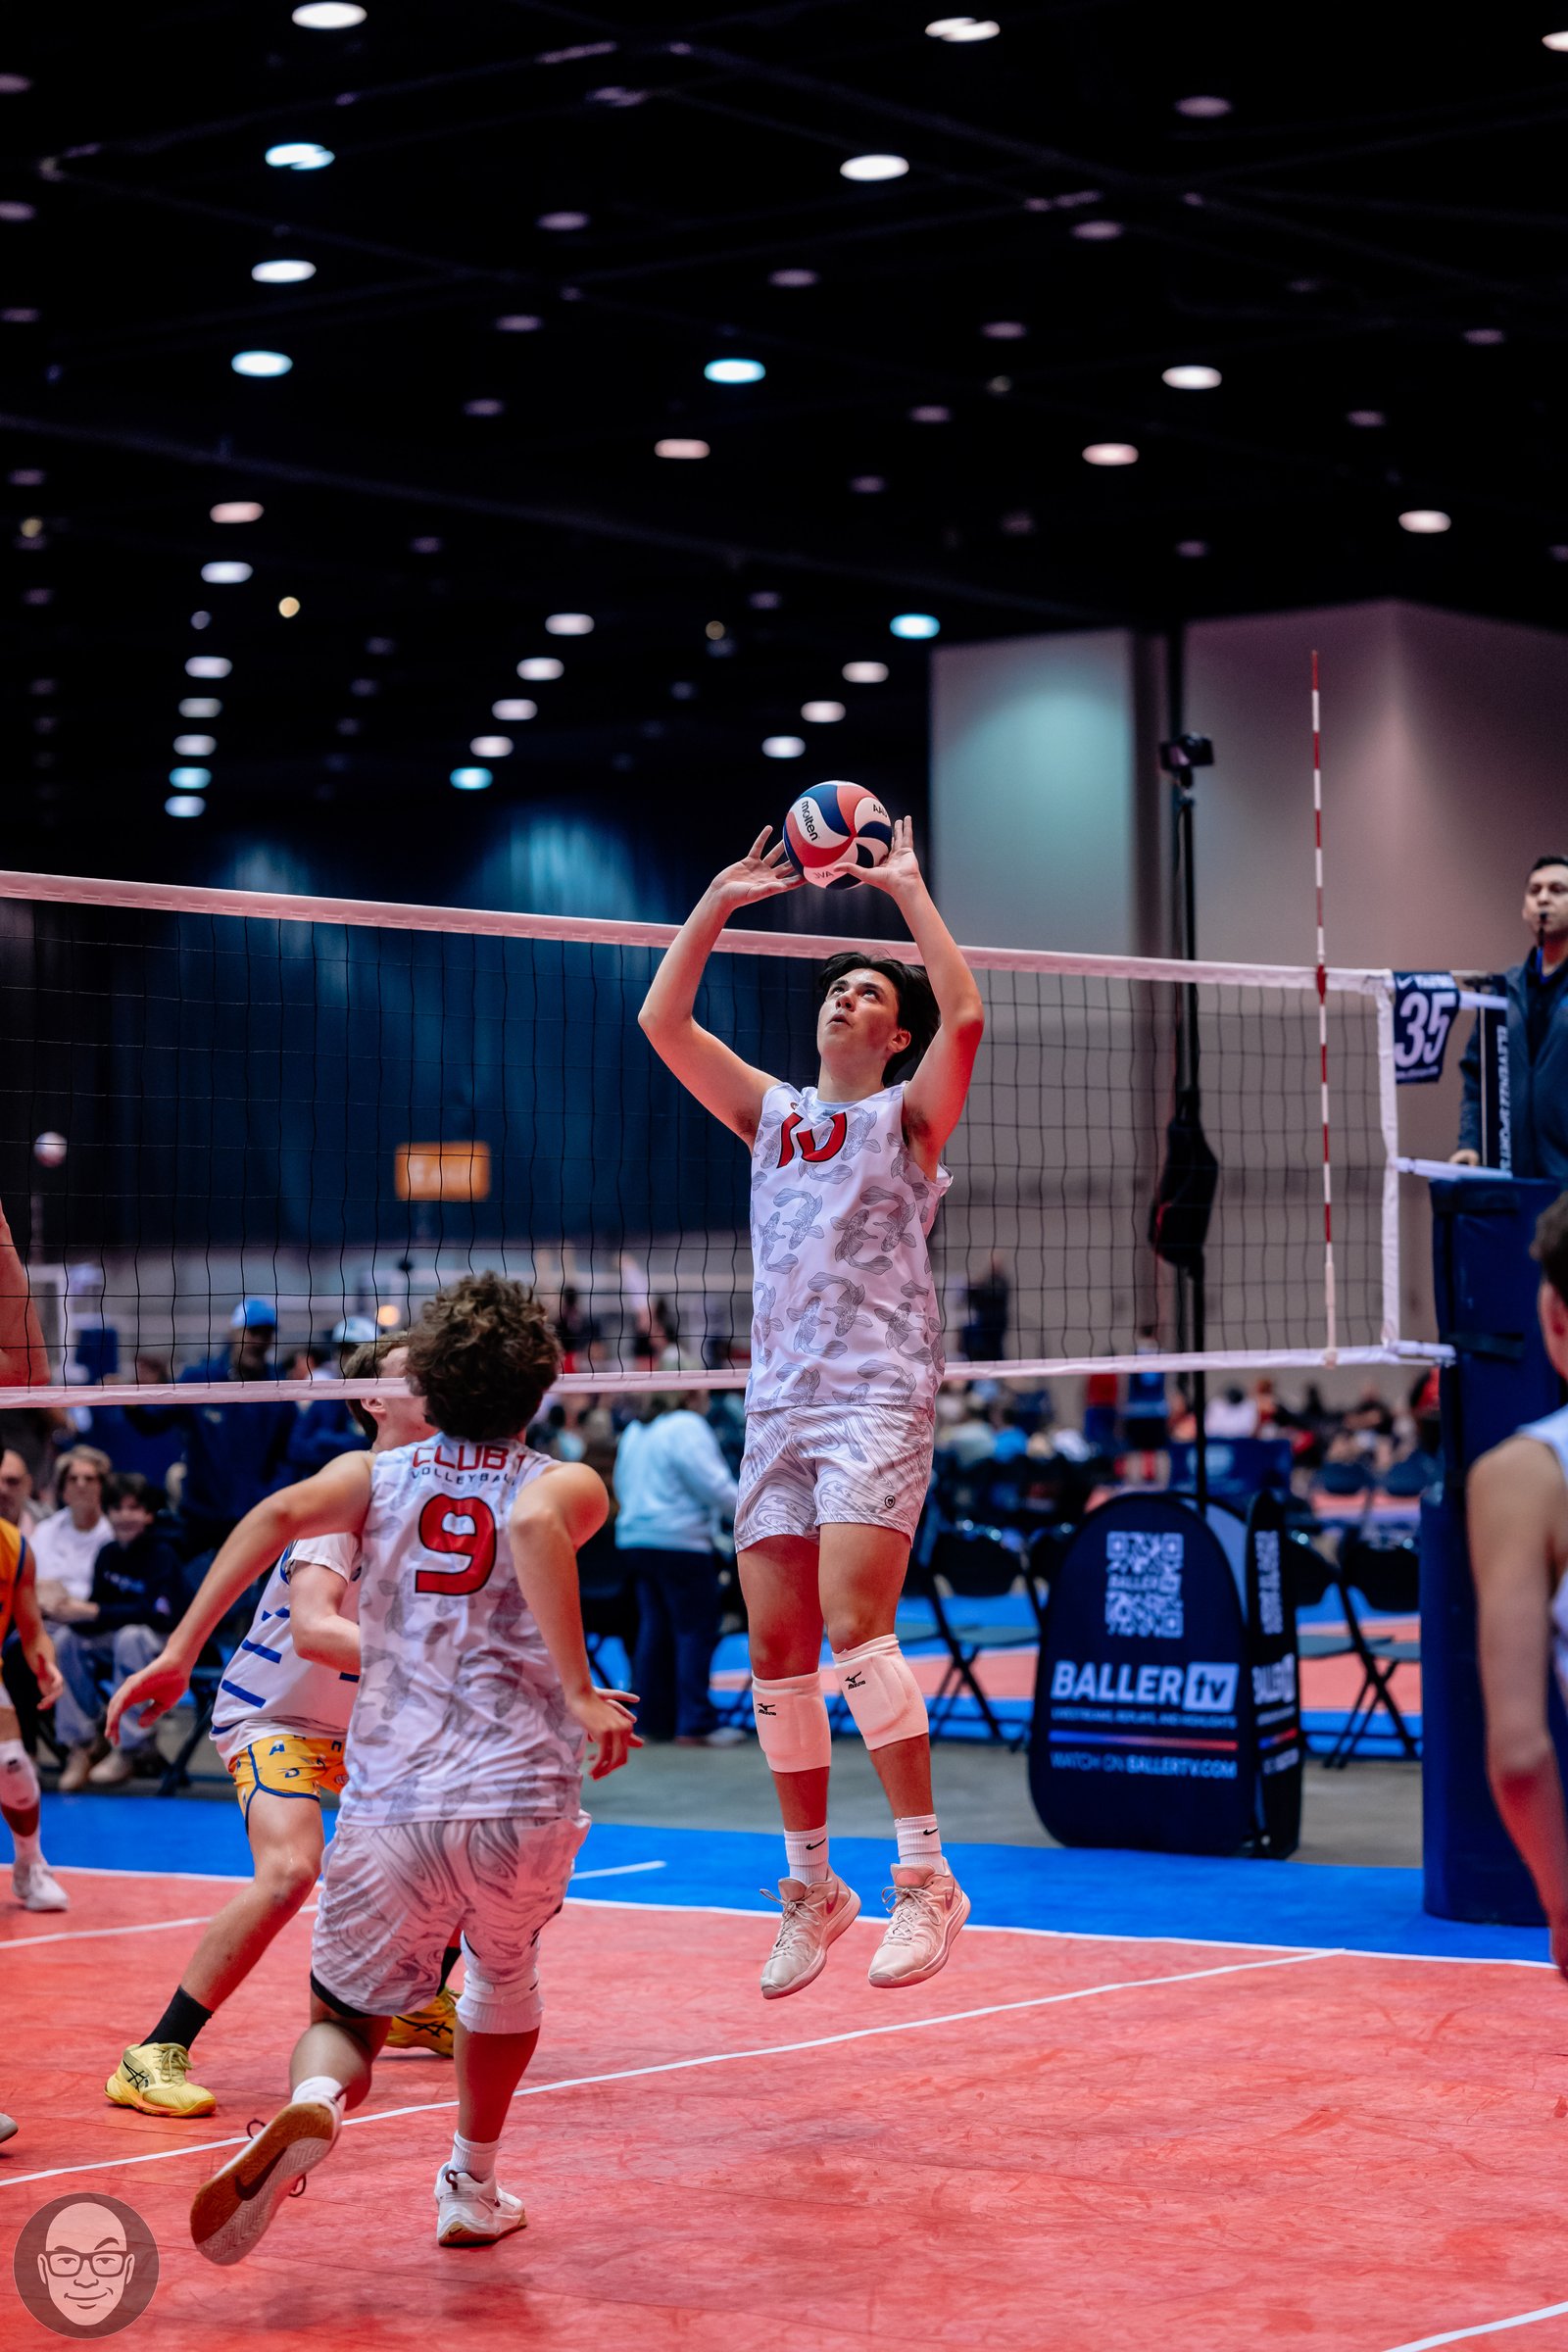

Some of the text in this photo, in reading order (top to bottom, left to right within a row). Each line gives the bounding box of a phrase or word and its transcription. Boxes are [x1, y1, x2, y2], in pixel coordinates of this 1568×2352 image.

[801, 801, 819, 841] molten
[1395, 992, 1457, 1068] 35
[413, 1445, 510, 1470] CLUB
[415, 1493, 497, 1596] 9
[1051, 1660, 1185, 1705] BALLER
